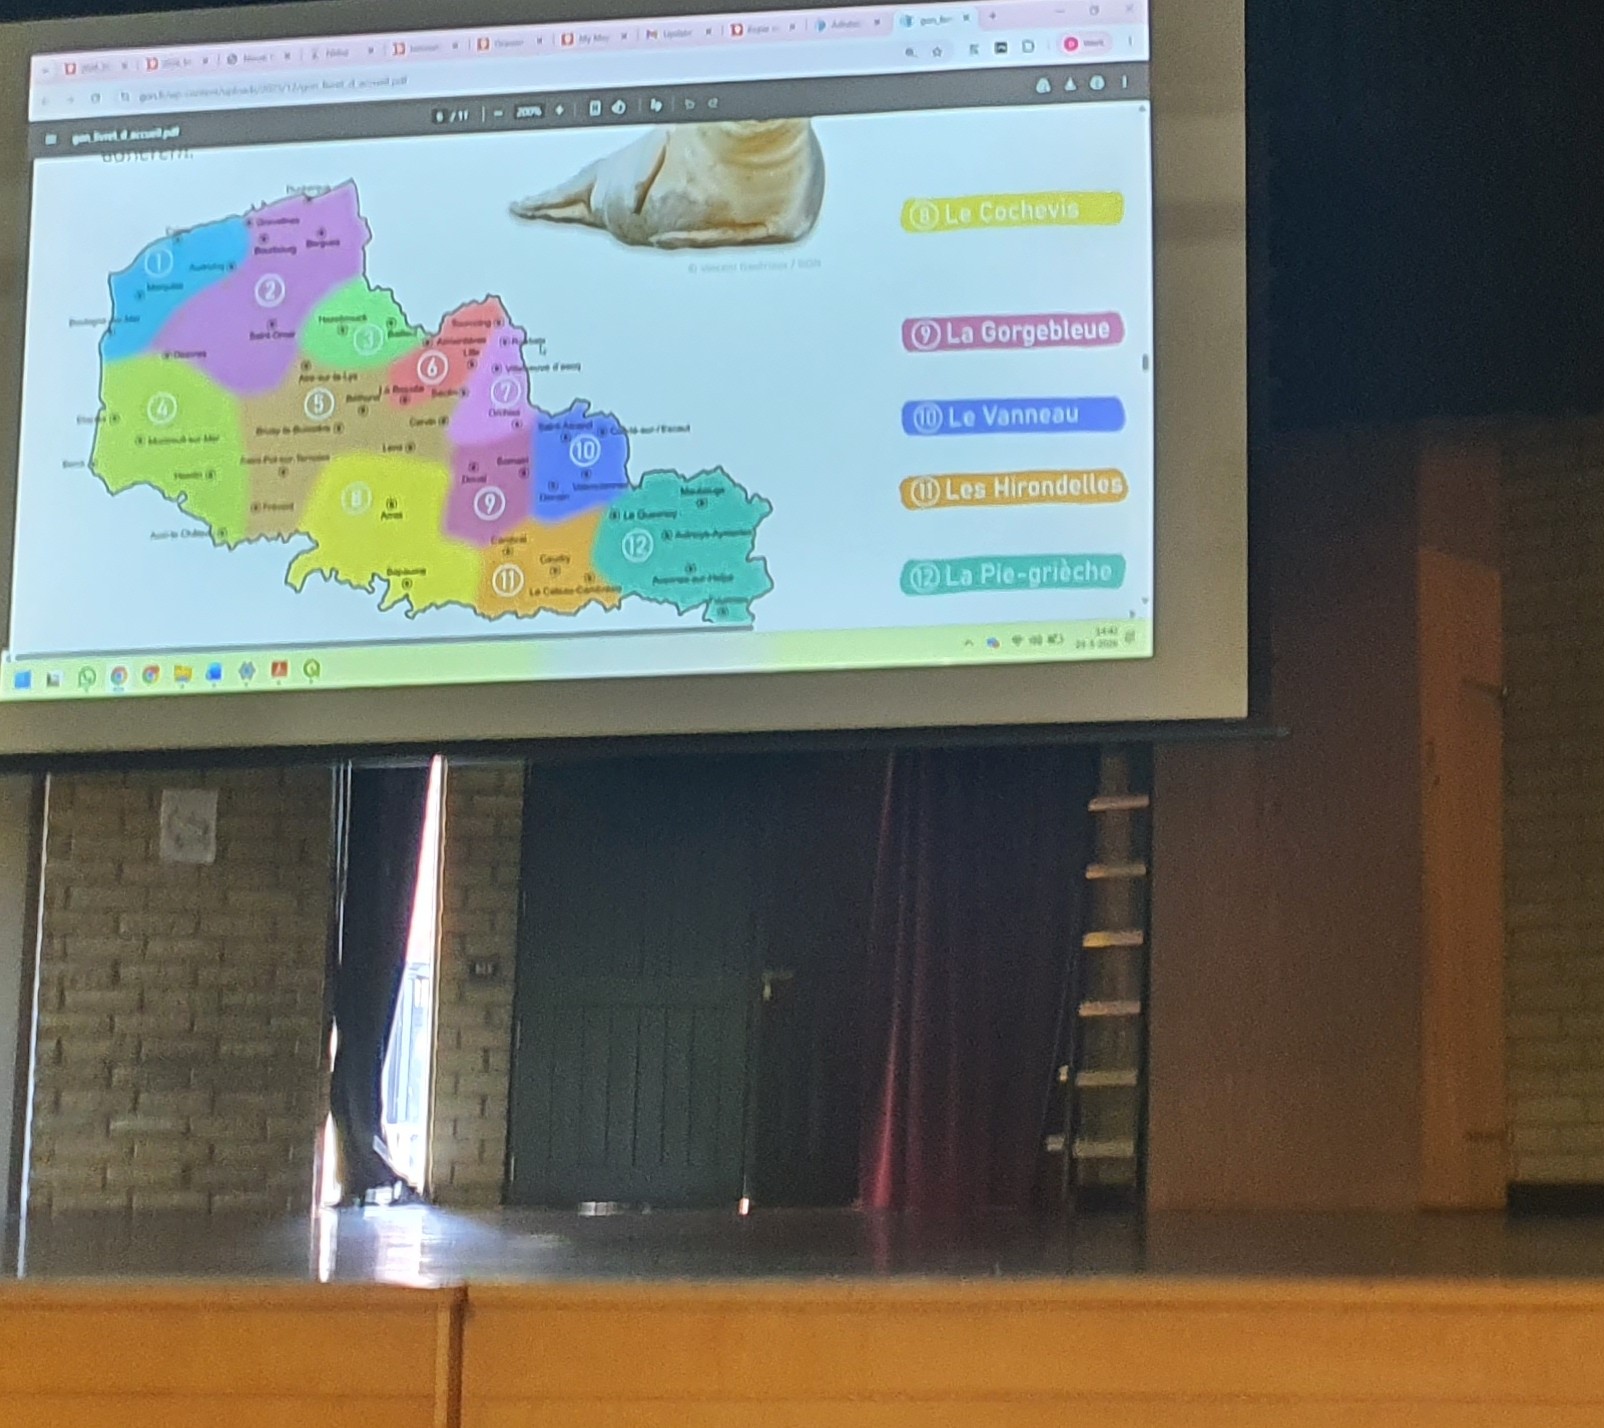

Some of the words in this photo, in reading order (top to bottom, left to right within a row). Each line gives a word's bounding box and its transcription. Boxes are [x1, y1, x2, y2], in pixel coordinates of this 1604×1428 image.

[945, 203, 972, 225] Le
[979, 197, 1081, 224] Cochevis
[946, 321, 975, 345] La
[981, 317, 1112, 348] Gorgebleue
[948, 406, 977, 428] Le
[982, 404, 1080, 427] Vanneau
[945, 478, 987, 501] Les
[993, 472, 1125, 499] Hirondelles
[944, 564, 974, 588] La
[979, 557, 1113, 588] Pie-grièche
